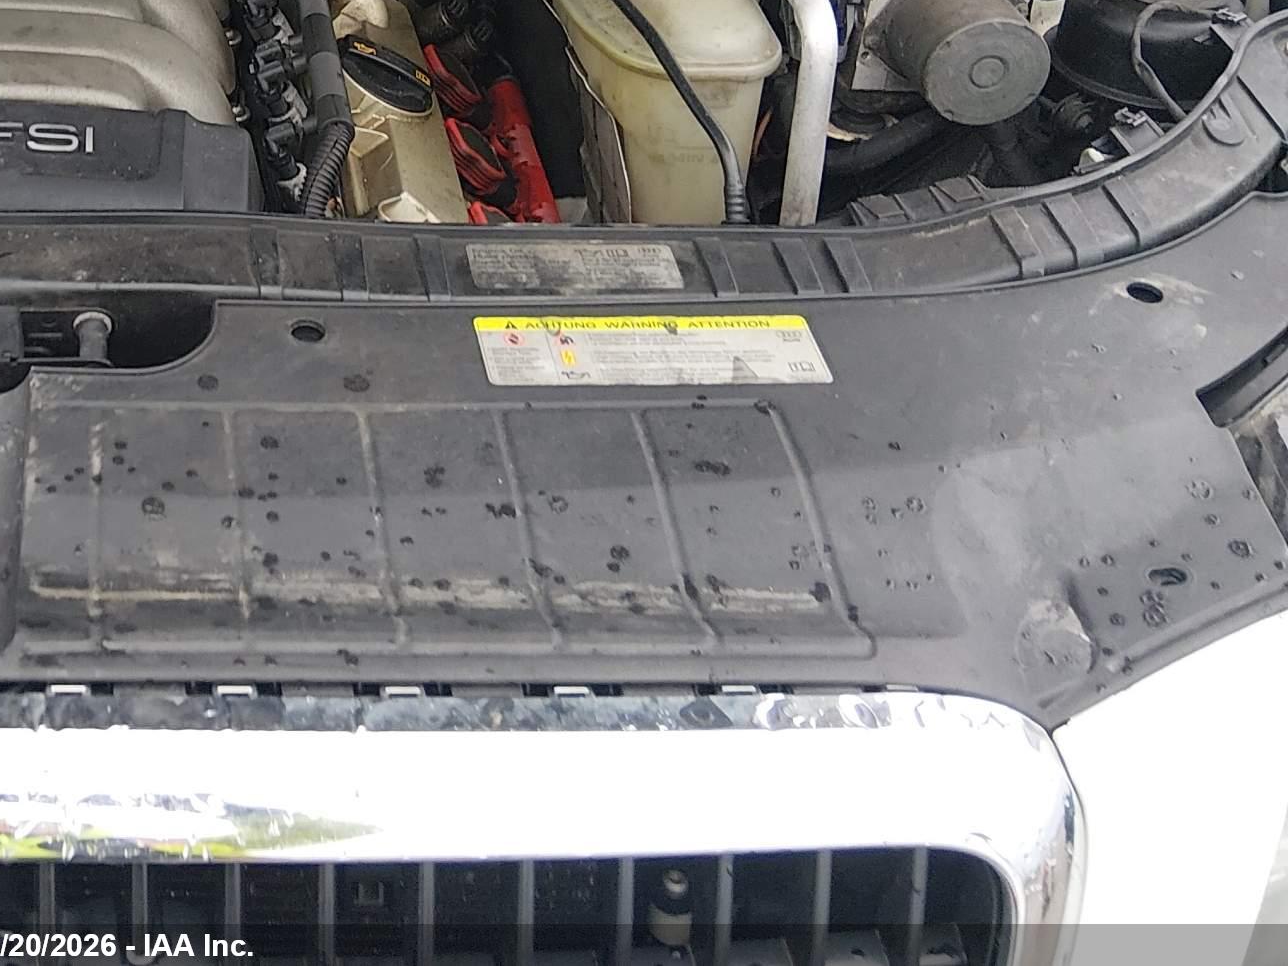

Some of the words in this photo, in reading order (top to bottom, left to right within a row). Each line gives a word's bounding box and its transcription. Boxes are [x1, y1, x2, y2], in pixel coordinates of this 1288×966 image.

[525, 320, 597, 330] ACHTUNG
[603, 320, 679, 330] WARNING
[687, 320, 770, 329] ATTENTION
